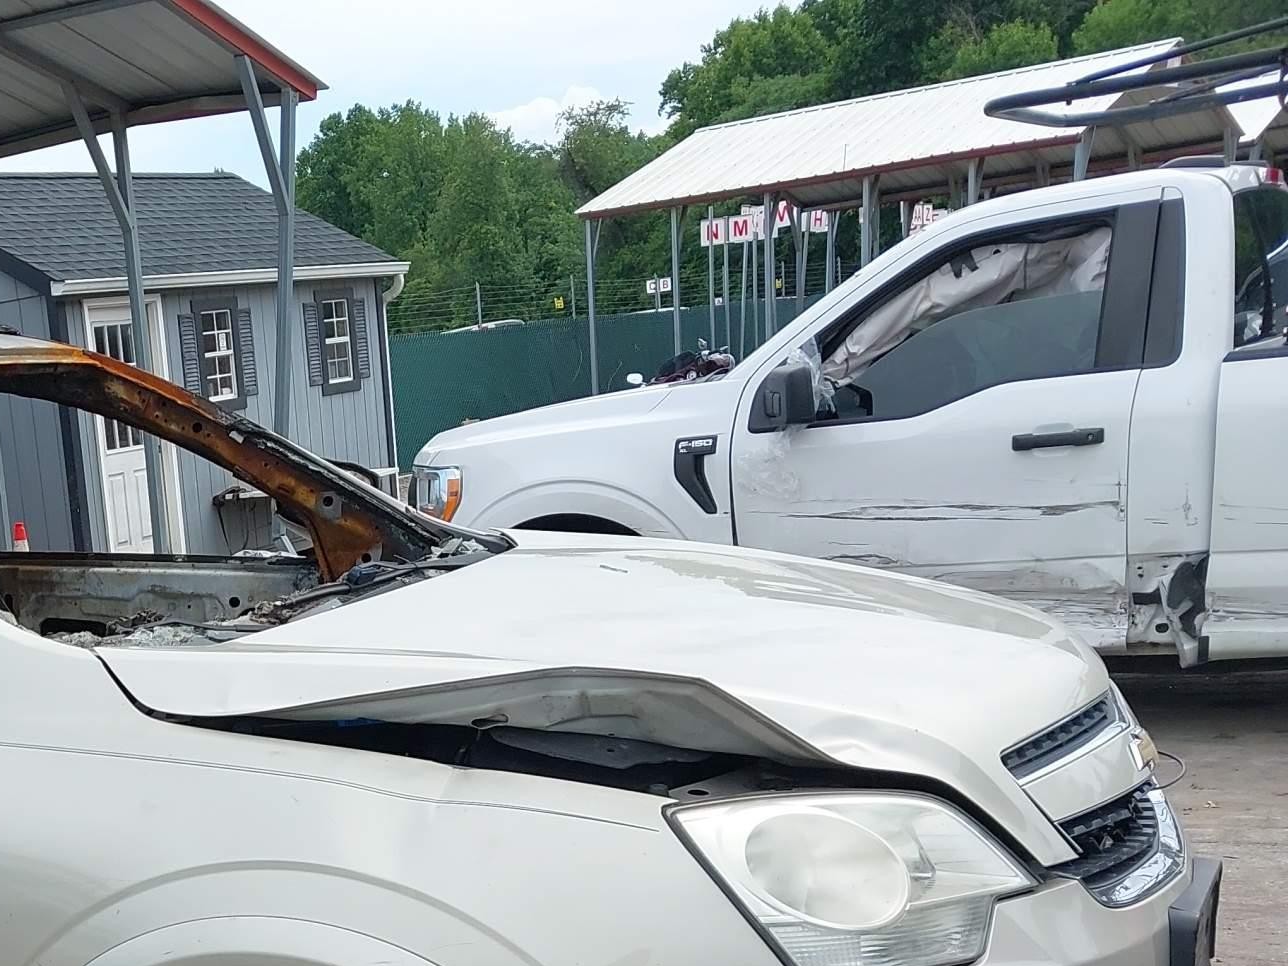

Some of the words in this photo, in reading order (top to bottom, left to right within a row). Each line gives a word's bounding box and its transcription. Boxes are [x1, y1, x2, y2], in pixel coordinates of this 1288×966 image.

[814, 211, 823, 227] H
[925, 207, 931, 222] Z
[707, 223, 719, 241] N
[733, 219, 748, 237] M
[678, 439, 713, 449] F-150
